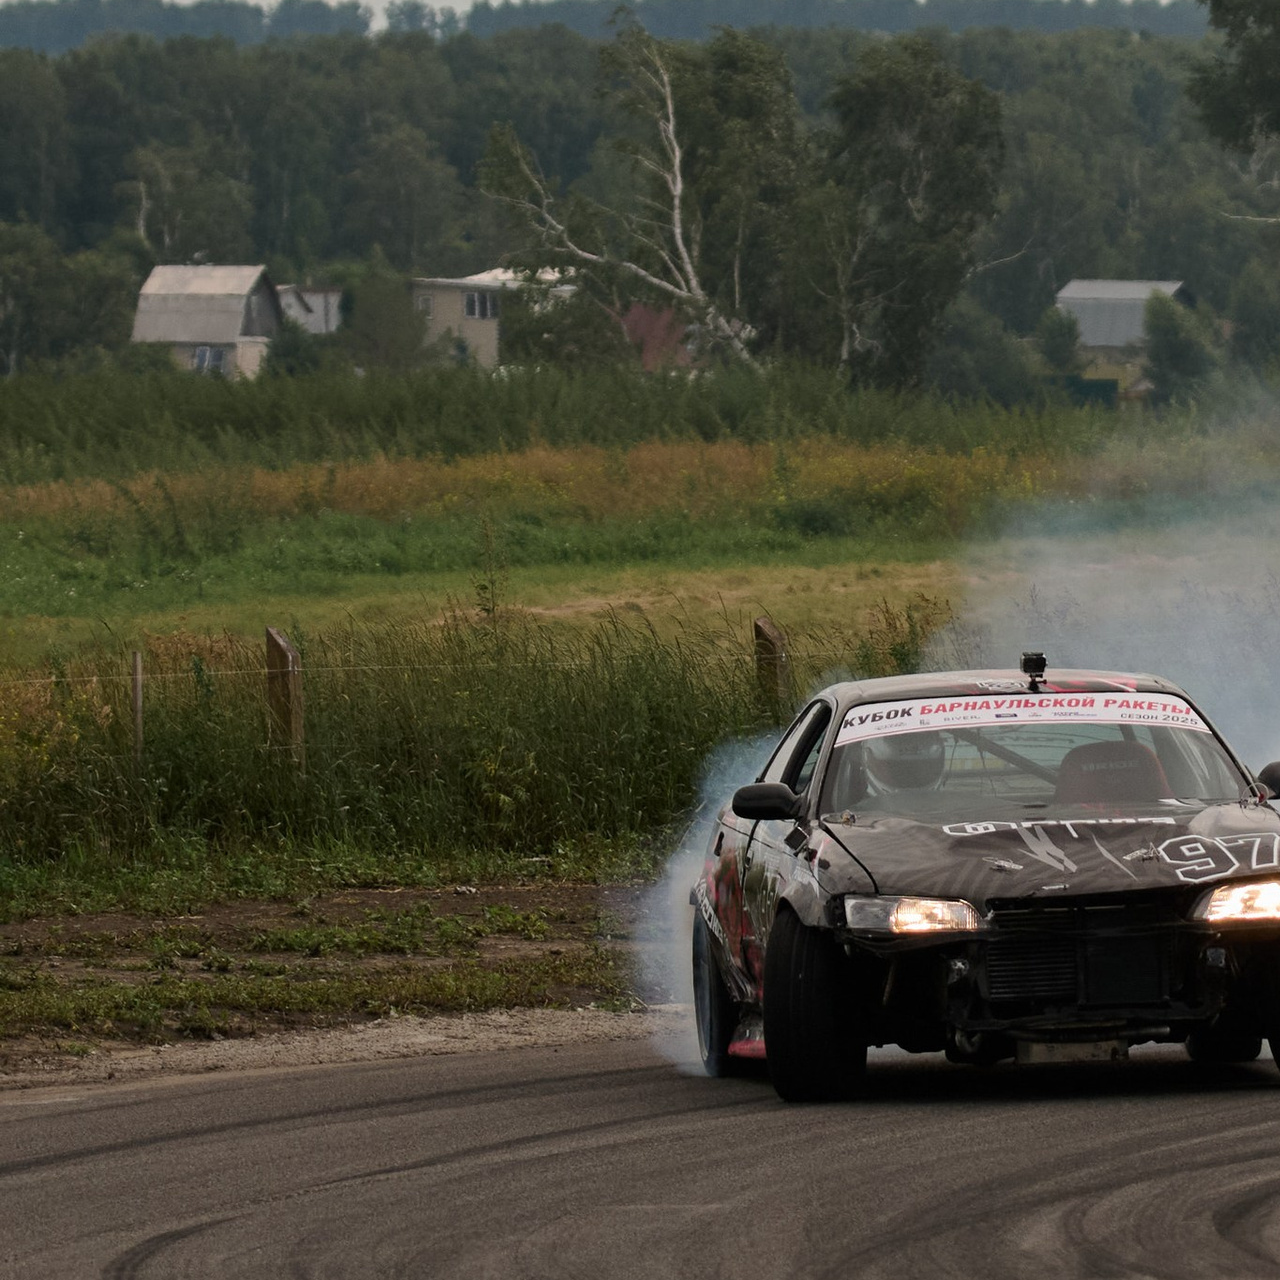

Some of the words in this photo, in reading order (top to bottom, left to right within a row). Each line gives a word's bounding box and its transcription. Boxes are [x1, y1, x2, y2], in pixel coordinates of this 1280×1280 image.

[842, 706, 913, 729] КУБОК
[920, 696, 1095, 716] БАРНАУЛЬСКОЙ
[1103, 698, 1192, 716] РАКЕТЫ
[1120, 712, 1158, 721] СЕЗОН
[1162, 714, 1199, 726] 2025
[1158, 833, 1280, 883] 97
